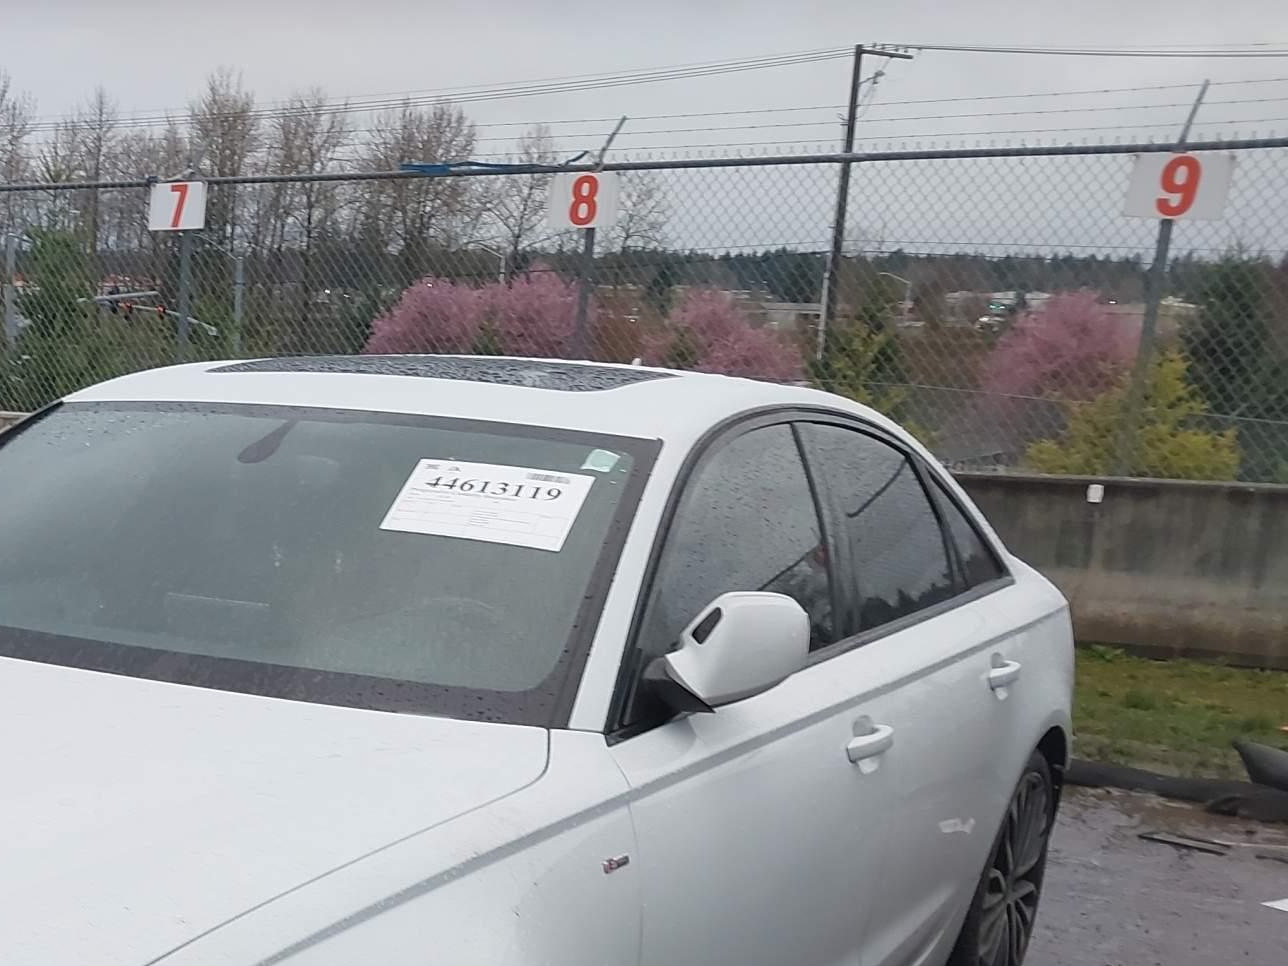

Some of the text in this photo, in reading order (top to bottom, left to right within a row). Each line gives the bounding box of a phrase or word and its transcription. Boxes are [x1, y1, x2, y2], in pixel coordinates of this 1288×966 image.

[169, 183, 189, 229] 7
[568, 174, 599, 226] 8
[1155, 154, 1202, 217] 9
[425, 476, 563, 501] 44613119
